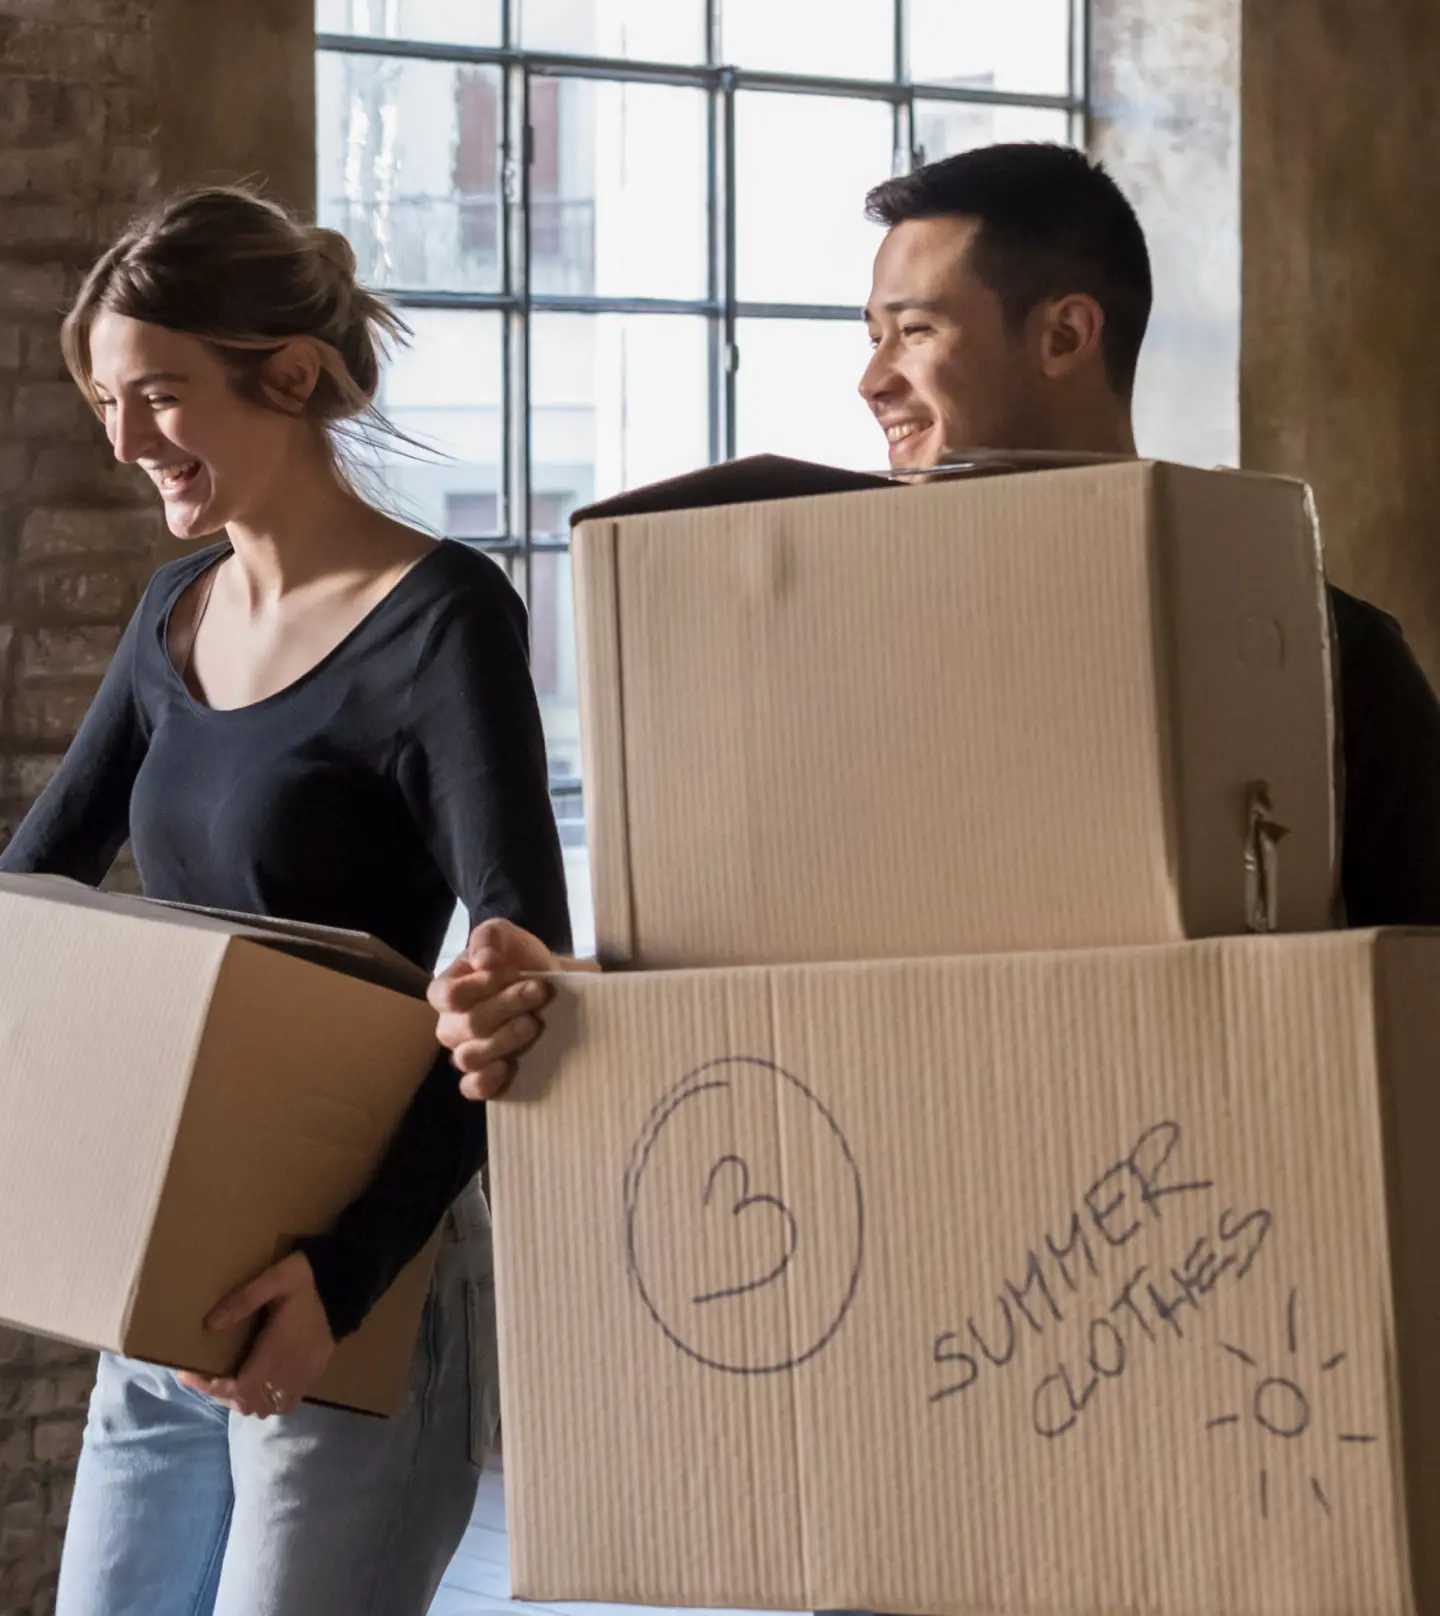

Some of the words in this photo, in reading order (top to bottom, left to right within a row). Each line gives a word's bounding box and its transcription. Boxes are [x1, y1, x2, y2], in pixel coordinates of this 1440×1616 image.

[692, 1155, 798, 1303] 3
[928, 1120, 1213, 1402] SUMMER
[1030, 1206, 1273, 1439] CLOTHES
